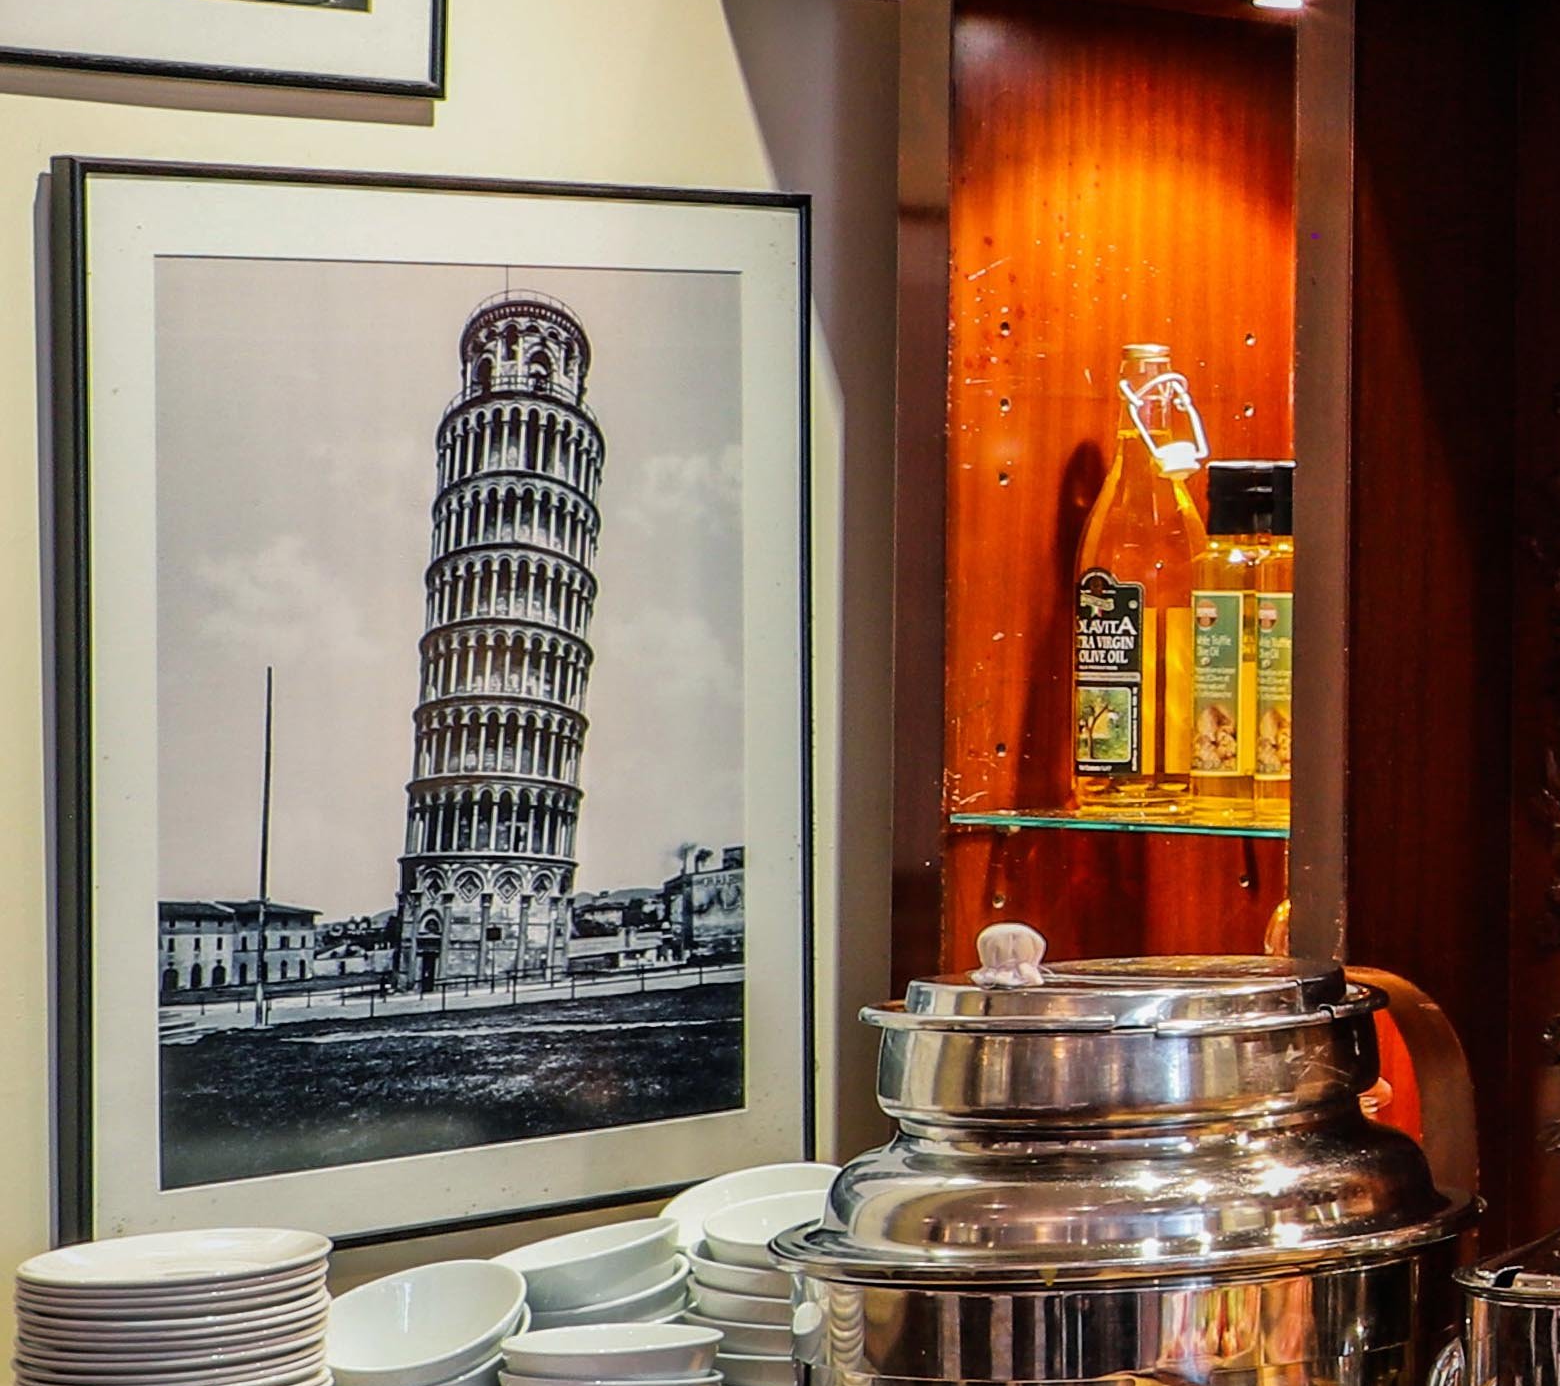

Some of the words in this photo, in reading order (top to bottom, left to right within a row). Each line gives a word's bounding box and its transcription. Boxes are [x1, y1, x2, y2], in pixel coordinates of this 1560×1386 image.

[1096, 635, 1136, 650] VIRGIN
[1079, 650, 1107, 664] OLIVE
[1107, 650, 1129, 664] OIL
